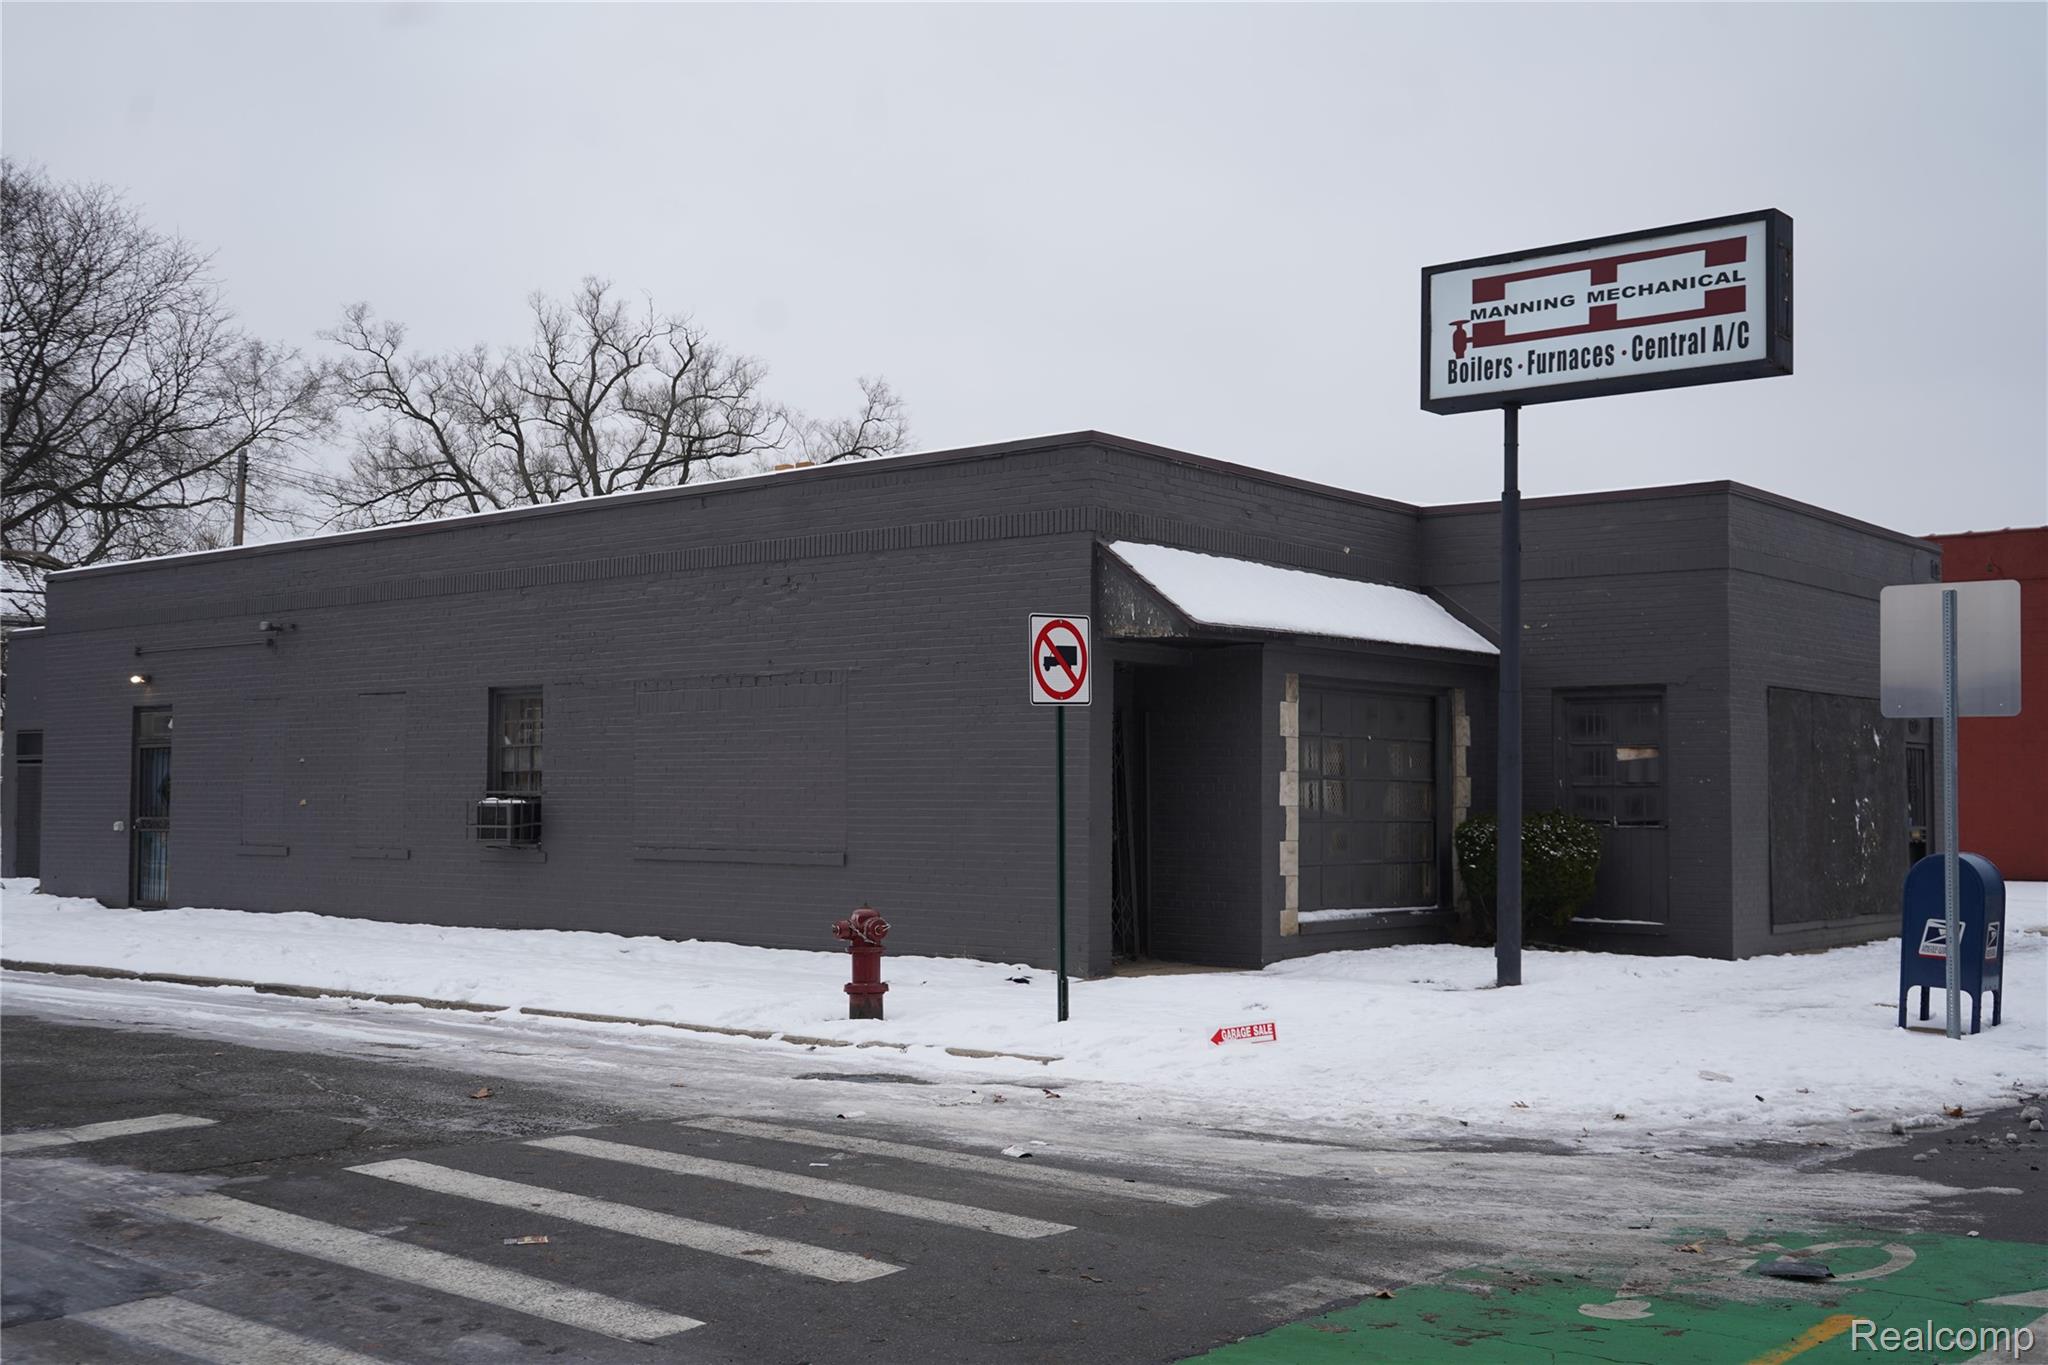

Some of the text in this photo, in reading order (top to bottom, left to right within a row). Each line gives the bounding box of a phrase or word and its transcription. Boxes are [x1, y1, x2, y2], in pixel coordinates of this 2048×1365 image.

[1470, 269, 1747, 321] MANNING MECHANICAL
[1447, 320, 1750, 385] Boilers Furnaces Central A/C
[1221, 1024, 1273, 1040] GARAGE SALE
